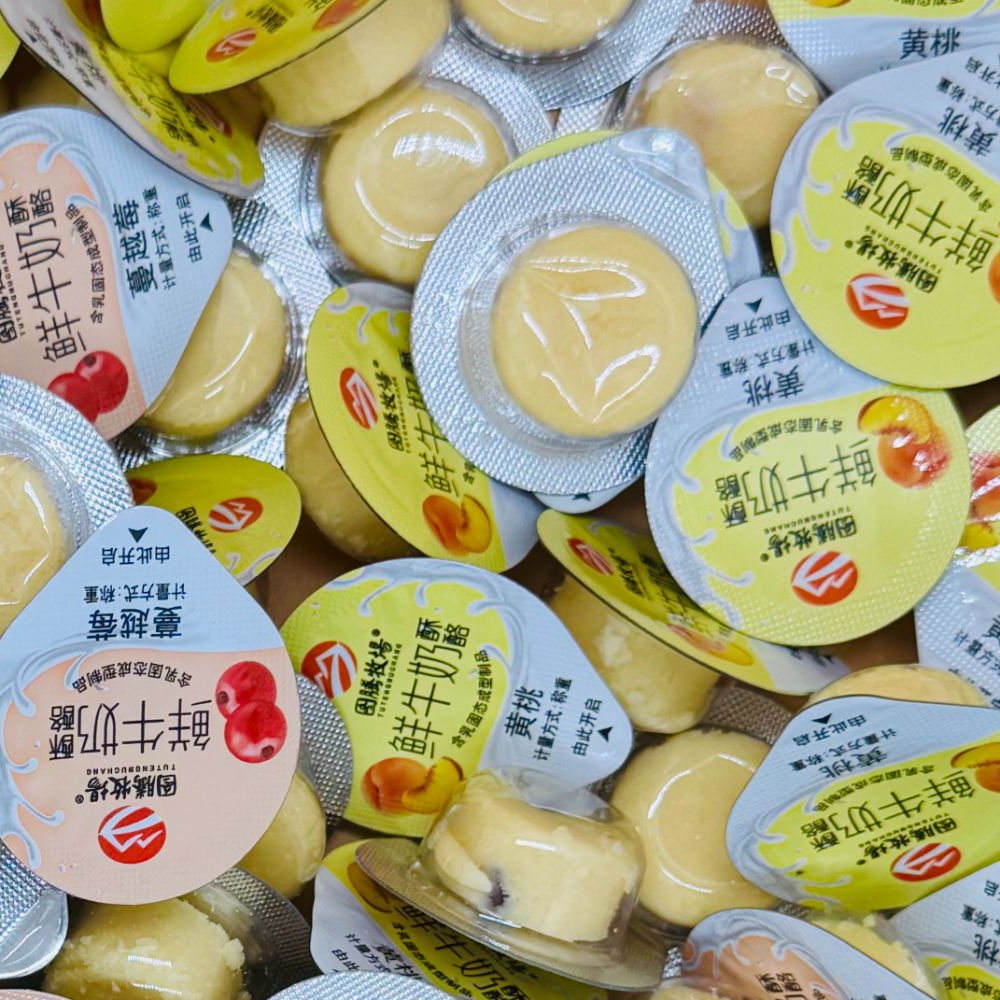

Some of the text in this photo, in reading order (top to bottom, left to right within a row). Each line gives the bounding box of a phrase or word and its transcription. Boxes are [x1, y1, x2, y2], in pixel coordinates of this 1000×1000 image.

[898, 26, 961, 59] 黄桃
[934, 103, 999, 162] 黄桃
[175, 191, 203, 264] 由此开启
[111, 196, 157, 300] 蔓越莓
[723, 309, 791, 341] 由此开启
[739, 364, 806, 408] 黄桃
[101, 545, 169, 565] 由此开启
[86, 605, 181, 640] 蔓越莓
[71, 661, 190, 692] 含乳固态成型制品
[500, 683, 547, 740] 黄桃
[572, 697, 603, 756] 由此开启
[794, 715, 865, 747] 由此开启
[816, 743, 890, 779] 黄桃
